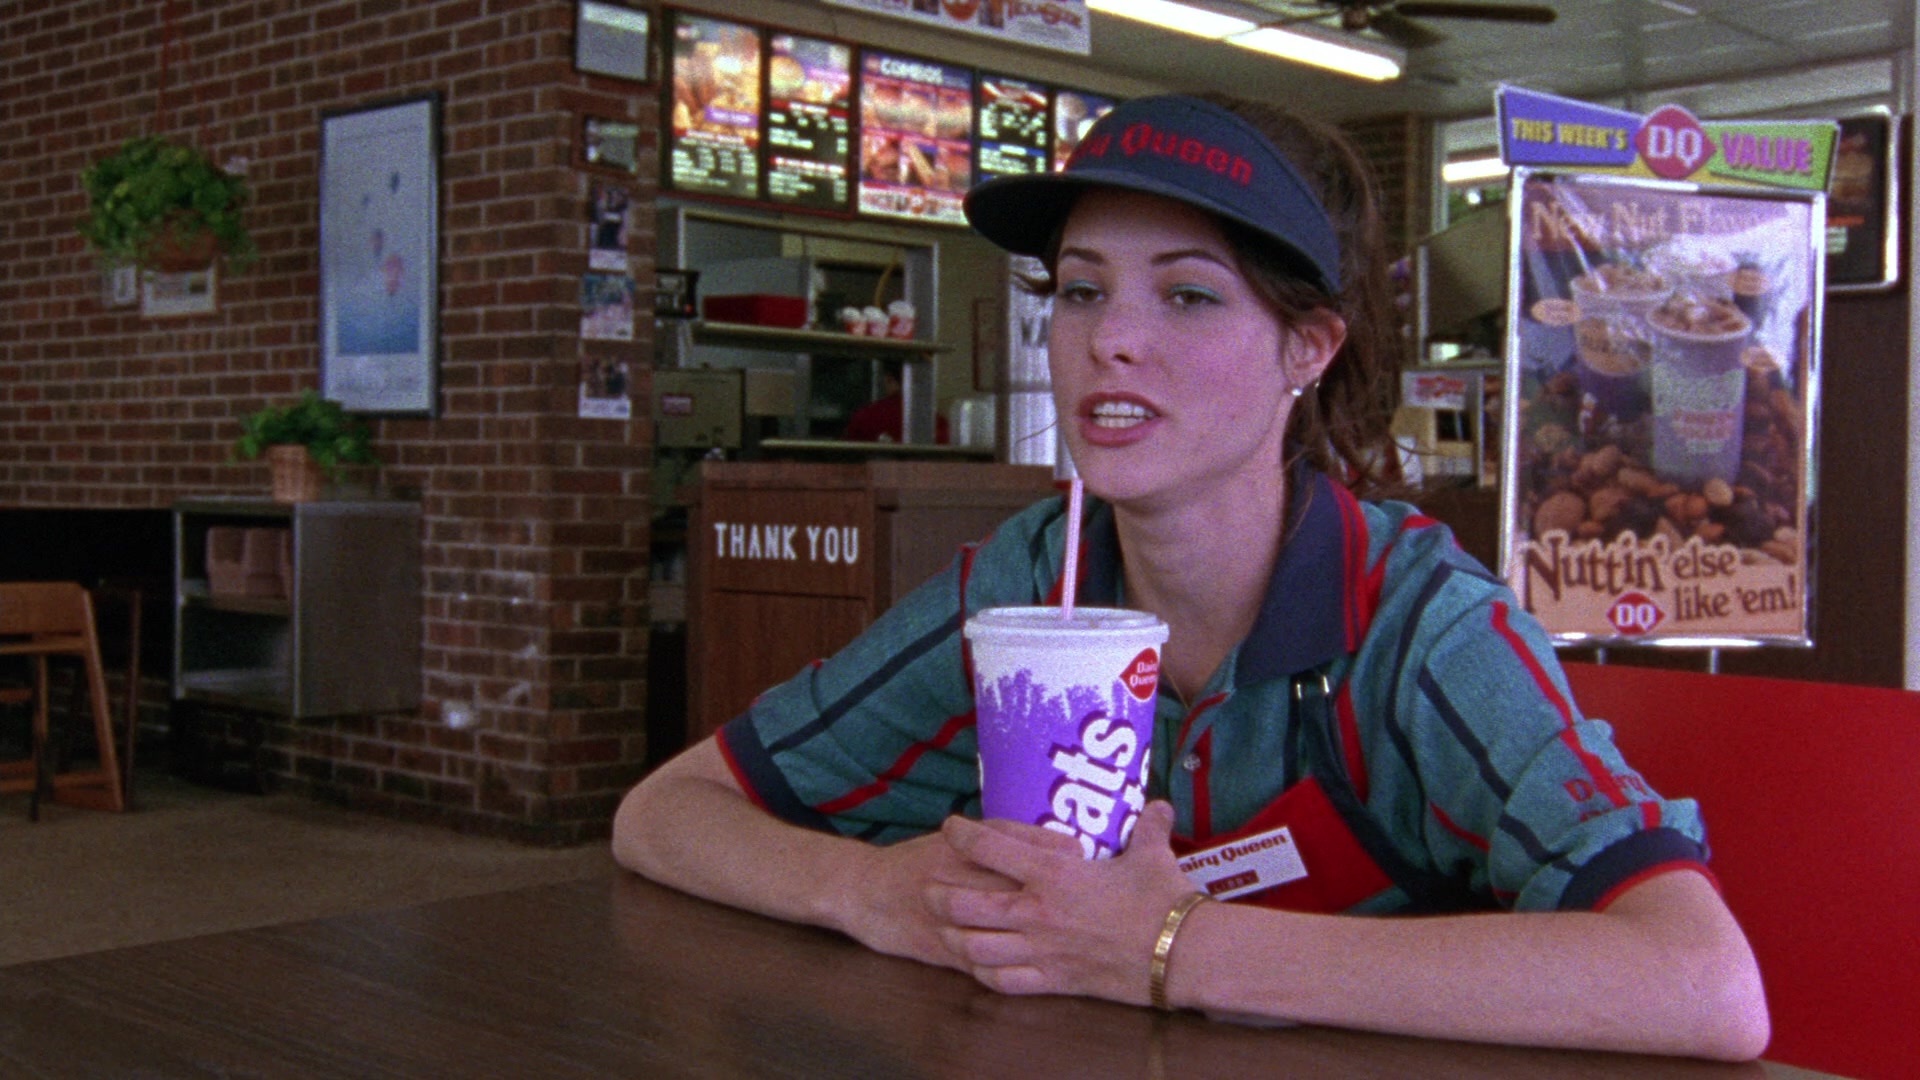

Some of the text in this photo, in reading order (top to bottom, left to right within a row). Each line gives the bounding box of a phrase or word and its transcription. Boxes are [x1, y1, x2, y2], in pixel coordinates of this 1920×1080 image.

[1119, 121, 1254, 187] Queen
[1511, 117, 1629, 151] THIS WEEK'S
[1647, 124, 1703, 169] DQ
[1720, 130, 1815, 174] VALUE
[714, 522, 859, 565] THANK YOU
[1525, 536, 1736, 614] Nuttin' else
[1616, 603, 1658, 632] DQ
[1674, 574, 1797, 622] like 'em!
[1178, 833, 1287, 874] airy Queen
